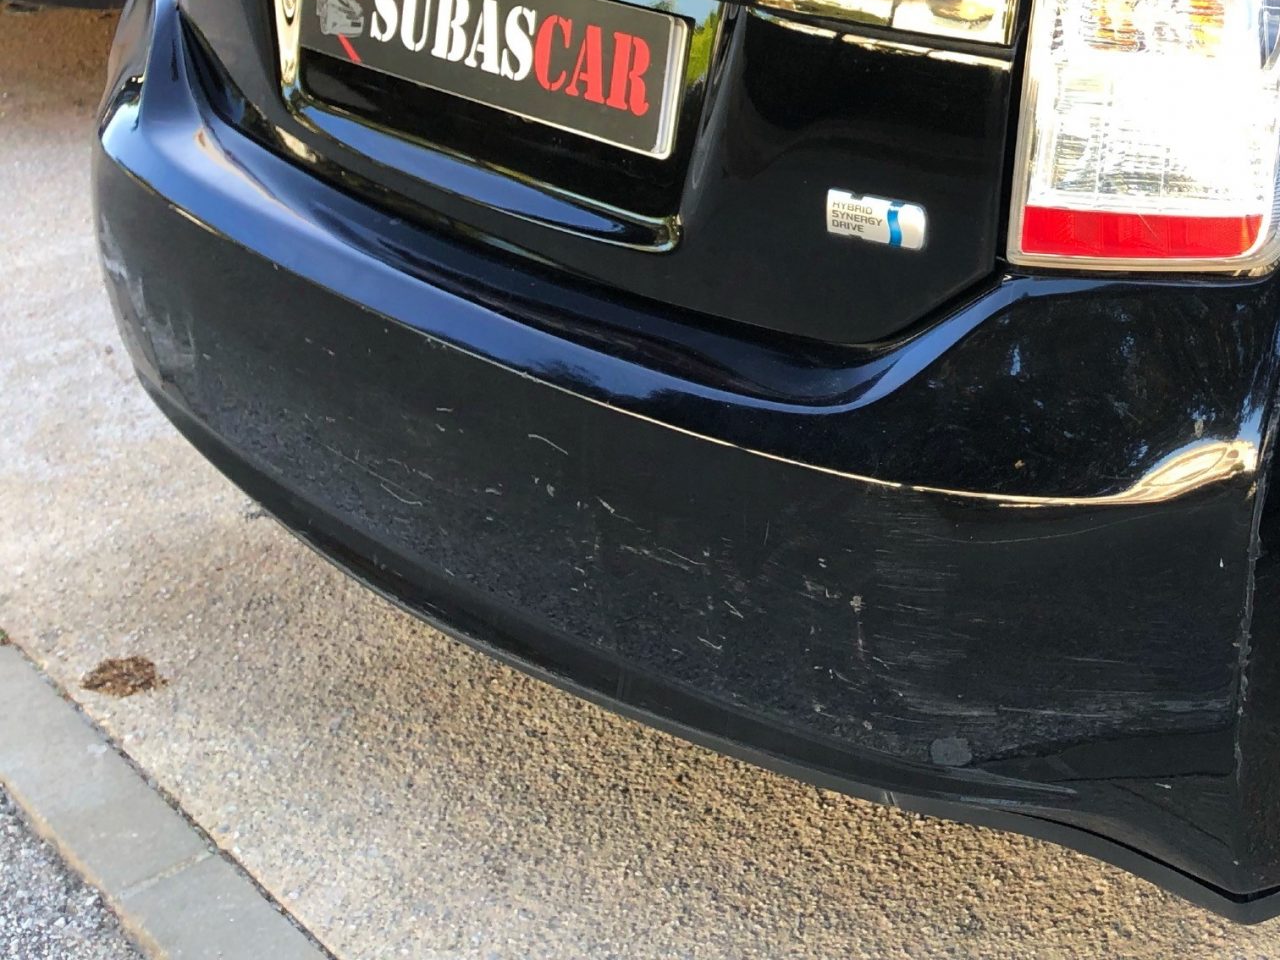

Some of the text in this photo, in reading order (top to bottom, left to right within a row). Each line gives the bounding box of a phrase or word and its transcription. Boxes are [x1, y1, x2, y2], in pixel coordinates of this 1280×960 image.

[832, 201, 873, 215] HYBRID
[832, 209, 883, 227] SYNERGY
[832, 219, 865, 233] DRIVE
